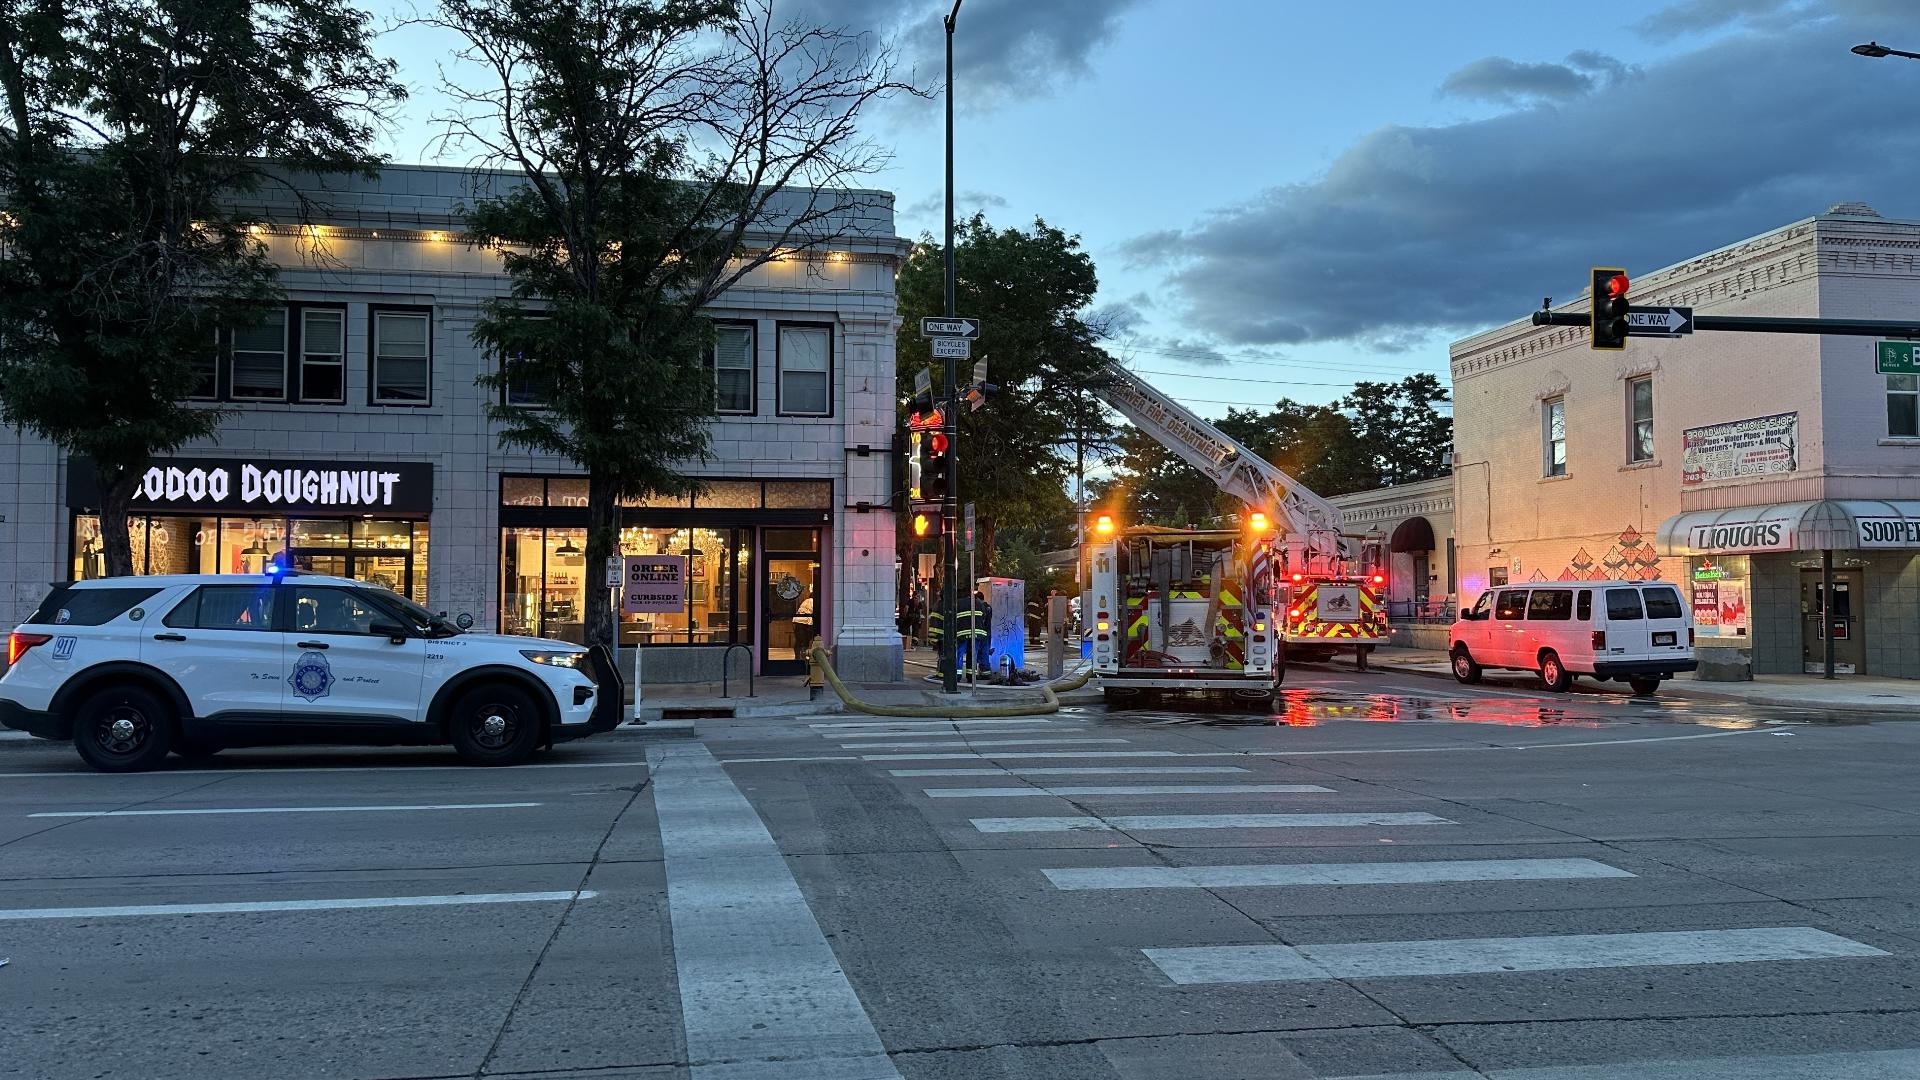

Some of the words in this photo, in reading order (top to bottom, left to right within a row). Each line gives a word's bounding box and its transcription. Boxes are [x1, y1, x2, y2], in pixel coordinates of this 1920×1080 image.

[1648, 314, 1669, 326] WAY
[1902, 354, 1908, 362] S
[1736, 420, 1767, 433] SMOKE
[1146, 406, 1166, 424] FIRE
[1167, 420, 1223, 462] DEPARTMENT
[1744, 432, 1760, 441] Pipes
[133, 466, 229, 501] ODOO
[242, 464, 401, 506] DOUGHNUT
[1698, 524, 1781, 549] LIQUORS
[376, 540, 386, 548] 98
[632, 564, 678, 572] ORDER
[1096, 558, 1110, 573] 11
[56, 637, 74, 654] 911
